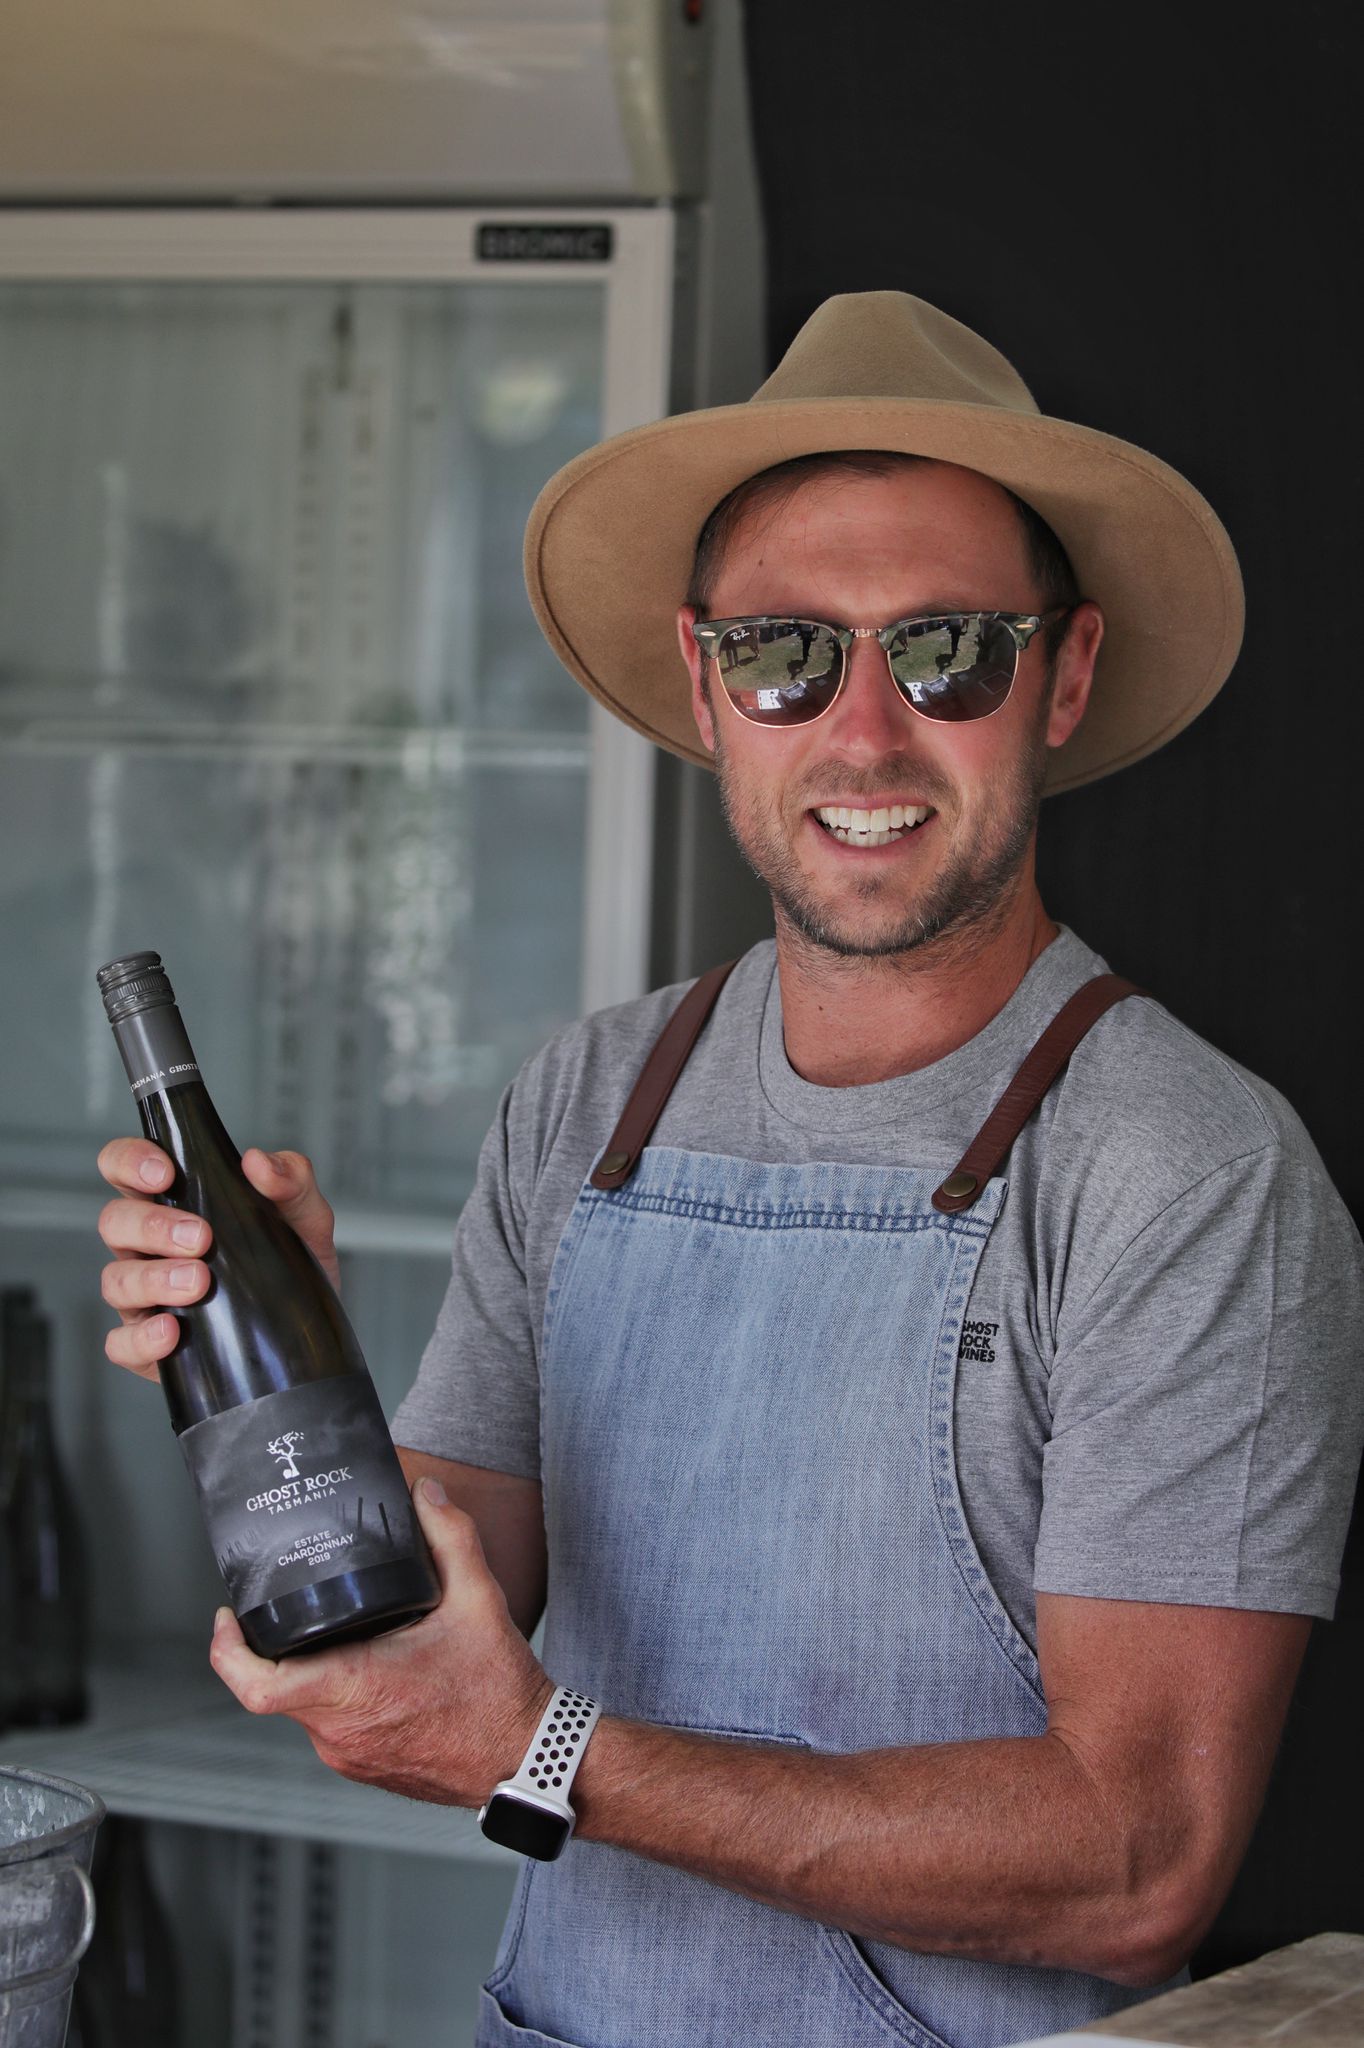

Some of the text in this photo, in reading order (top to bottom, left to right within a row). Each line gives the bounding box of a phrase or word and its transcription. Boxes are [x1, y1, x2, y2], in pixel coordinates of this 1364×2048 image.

[960, 1334, 991, 1349] OCK
[246, 1467, 354, 1511] GHOST ROCK
[268, 1487, 337, 1515] TASMANIA
[278, 1533, 354, 1566] CHARDONNAY
[294, 1530, 331, 1549] ESTATE
[308, 1552, 331, 1566] 2019
